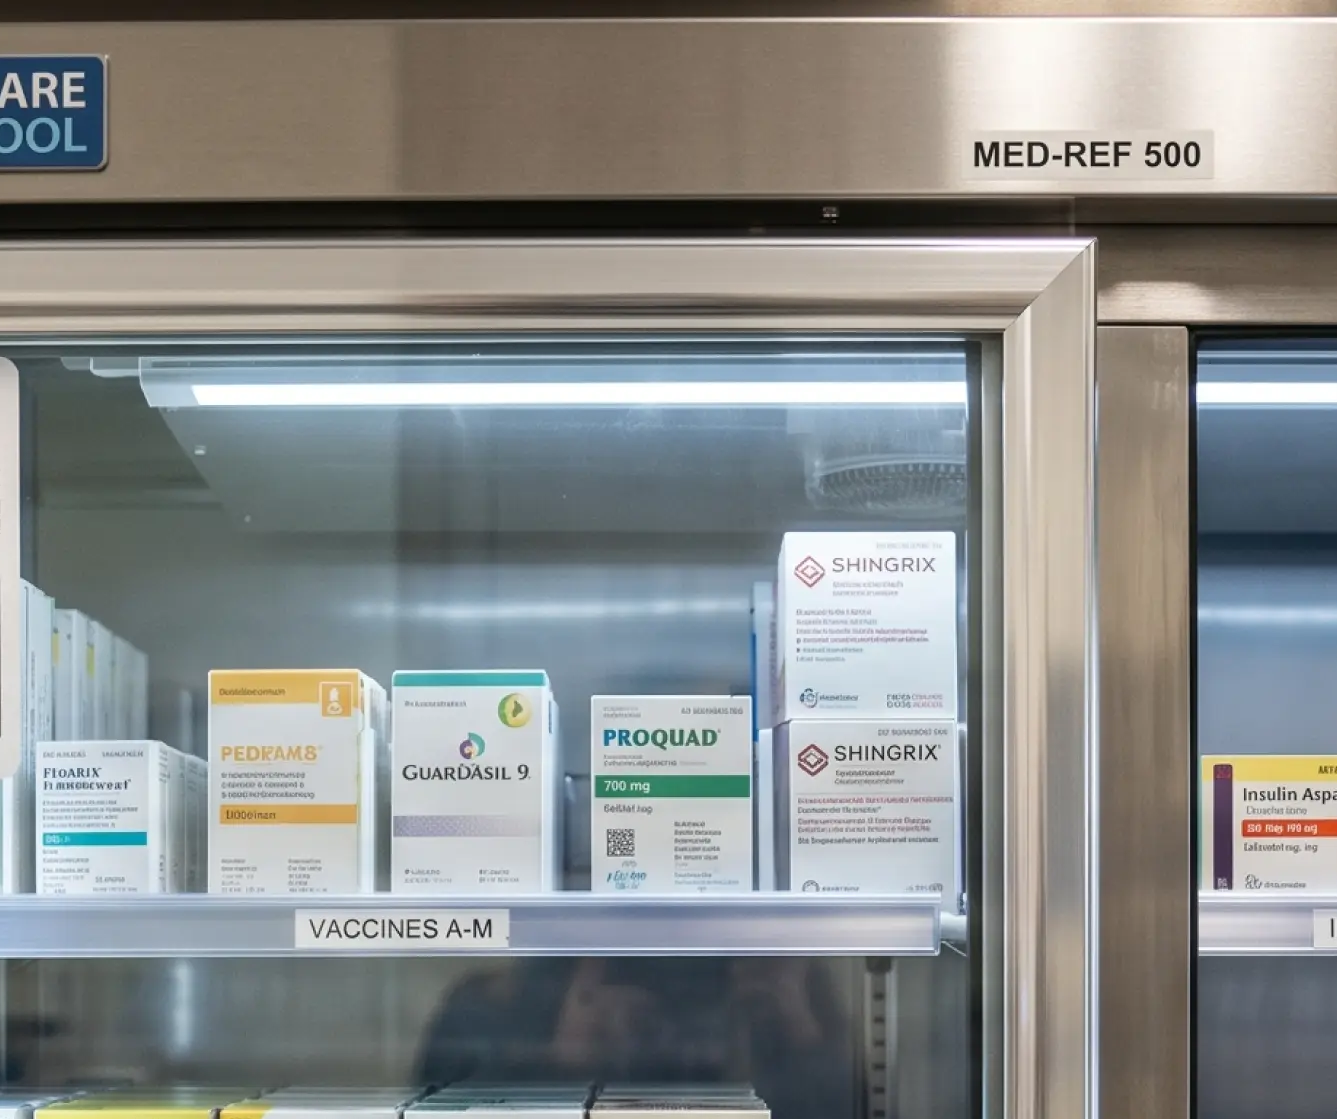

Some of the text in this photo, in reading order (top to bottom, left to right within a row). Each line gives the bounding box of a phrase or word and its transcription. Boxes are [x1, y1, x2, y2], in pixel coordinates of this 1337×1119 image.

[973, 141, 1201, 167] MED-REF 500
[832, 556, 936, 573] SHINGRIX
[602, 728, 718, 750] PROQUAD
[834, 745, 938, 762] SHINGRIX
[629, 782, 651, 793] mg
[1243, 787, 1297, 802] Insulin
[309, 918, 493, 939] VACCINES A-M
